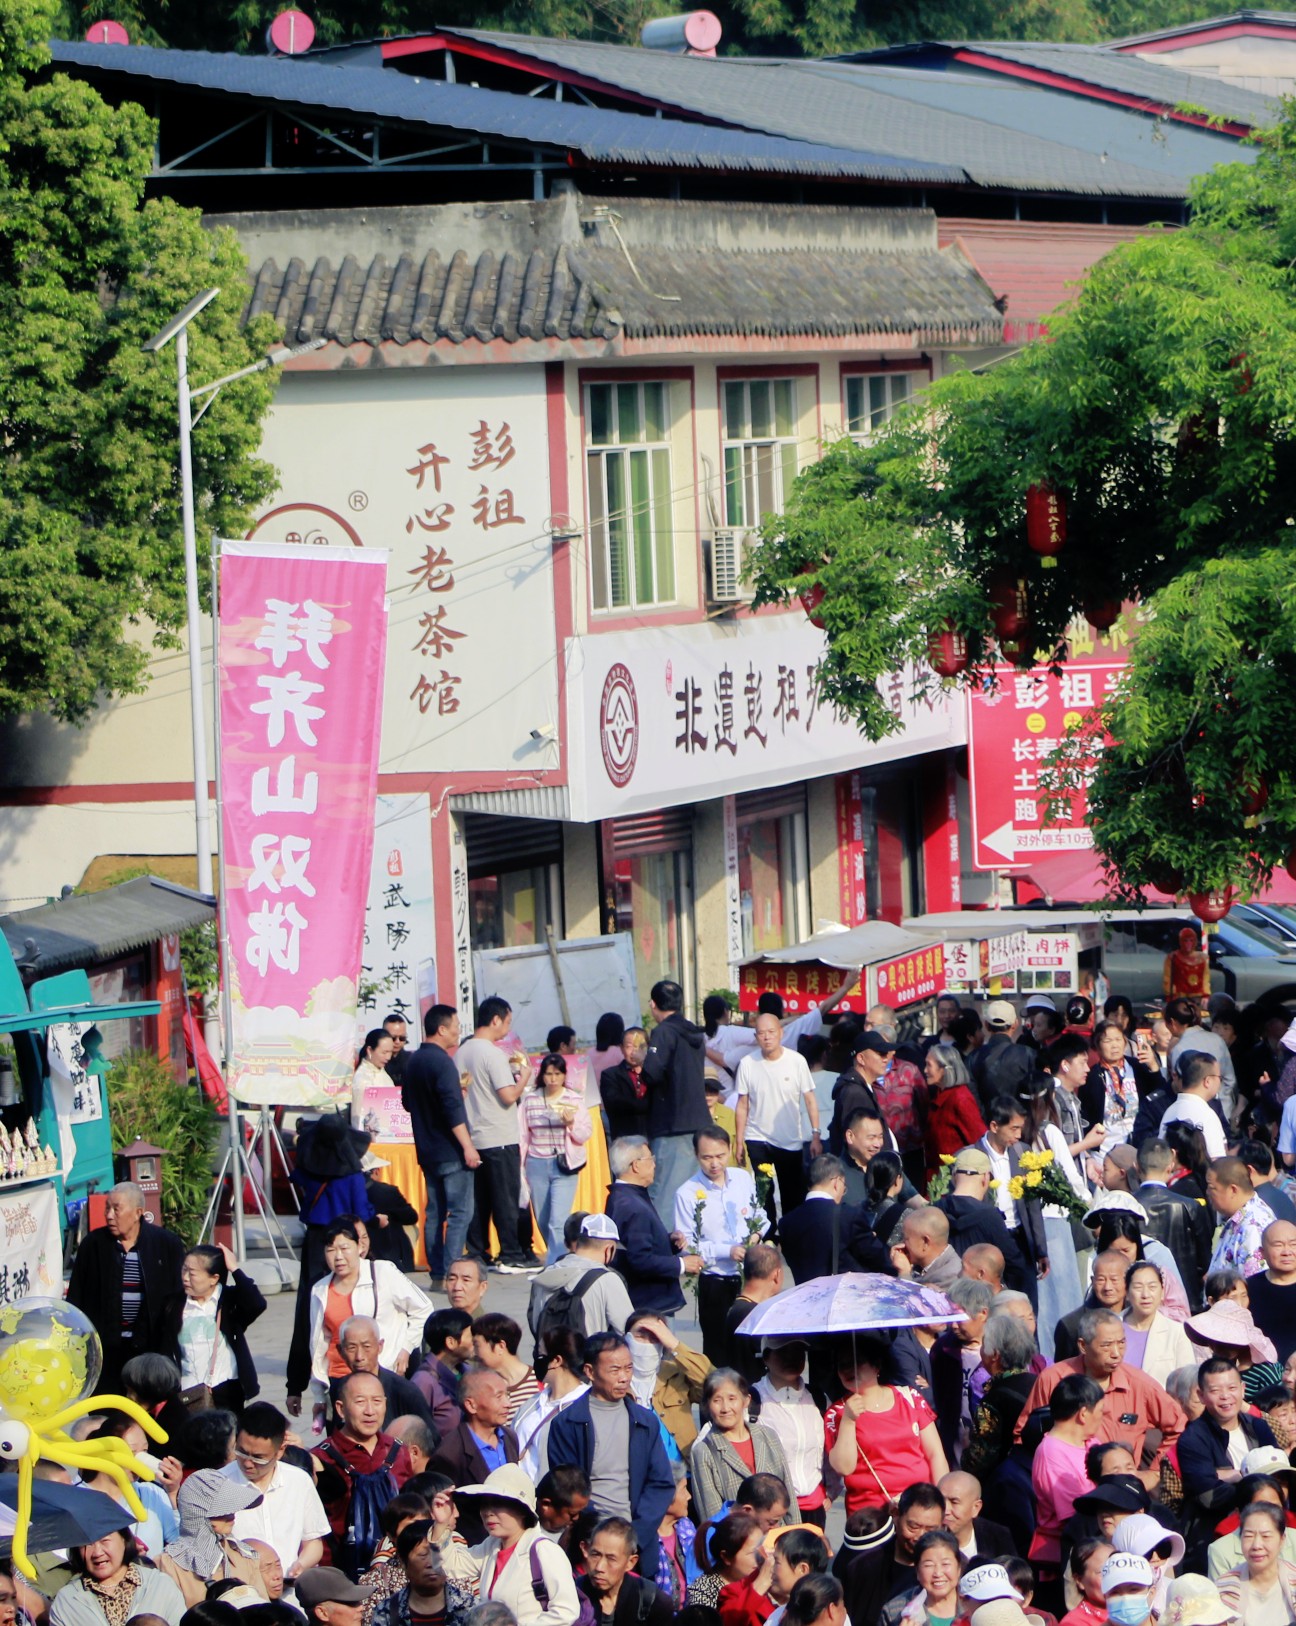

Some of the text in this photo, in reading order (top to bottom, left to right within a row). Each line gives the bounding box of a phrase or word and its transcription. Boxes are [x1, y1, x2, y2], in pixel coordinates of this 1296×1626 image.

[466, 419, 526, 531] 彭祖
[405, 442, 468, 717] 开心老茶馆
[1102, 1557, 1147, 1577] SPORT
